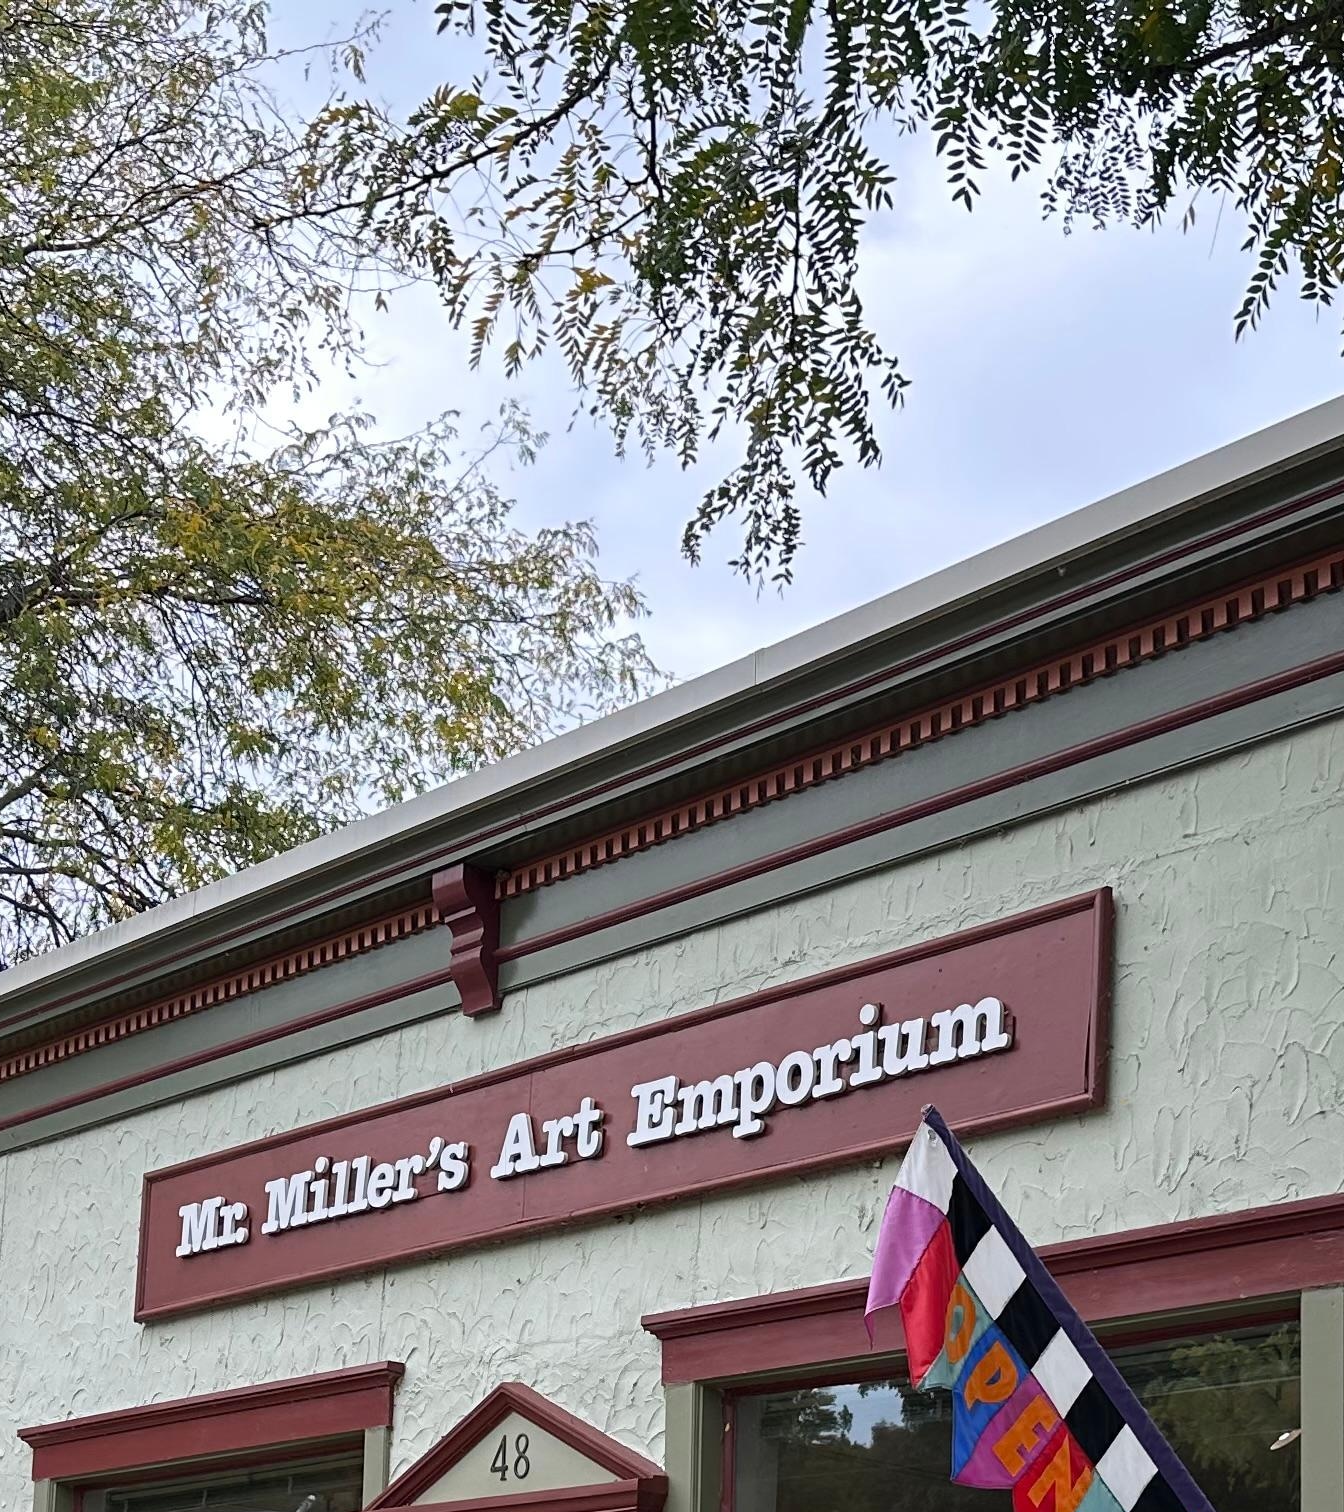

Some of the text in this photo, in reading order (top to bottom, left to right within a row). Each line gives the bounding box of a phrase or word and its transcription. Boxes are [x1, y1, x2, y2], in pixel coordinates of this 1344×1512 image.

[176, 996, 1014, 1258] Mr. Miller's Art Emporium
[490, 1433, 531, 1482] 48
